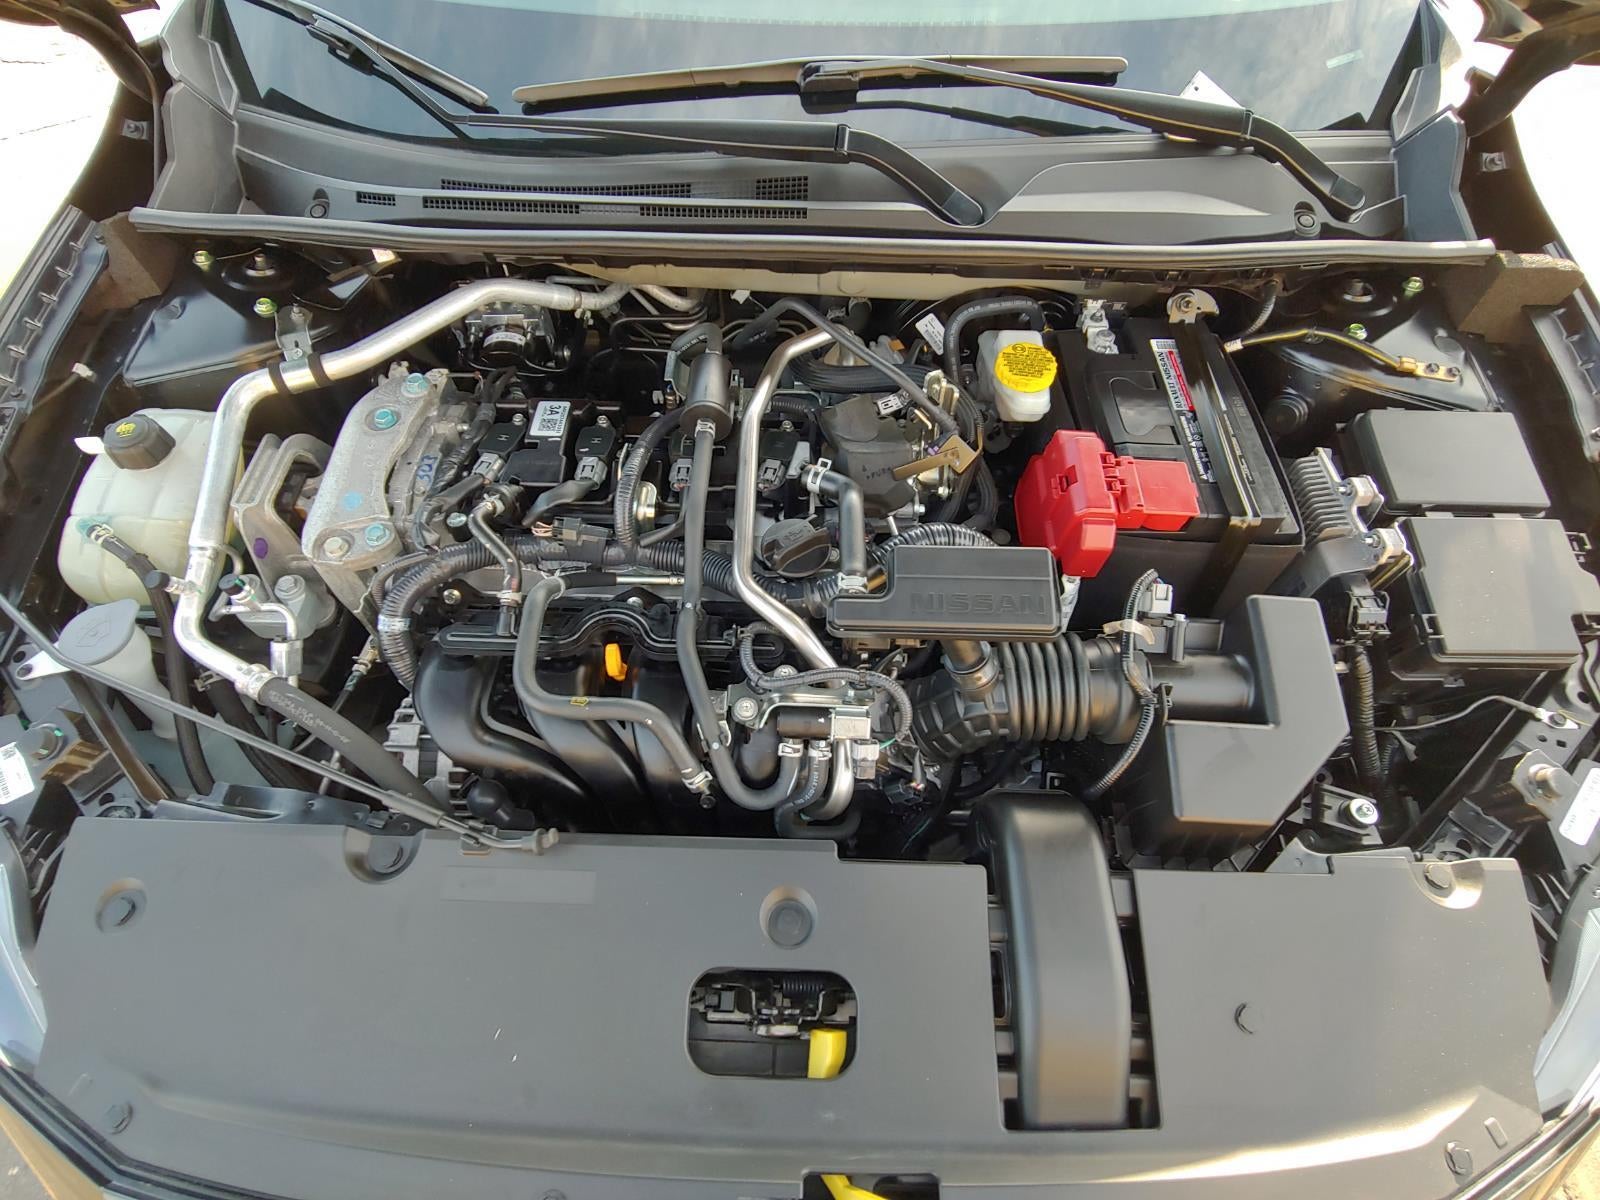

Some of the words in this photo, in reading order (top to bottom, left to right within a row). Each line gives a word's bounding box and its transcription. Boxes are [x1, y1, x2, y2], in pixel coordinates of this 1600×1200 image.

[1156, 351, 1173, 381] NISSAN
[1168, 381, 1184, 409] RENAULT
[547, 404, 562, 416] 3A
[910, 592, 1048, 615] NISSAN
